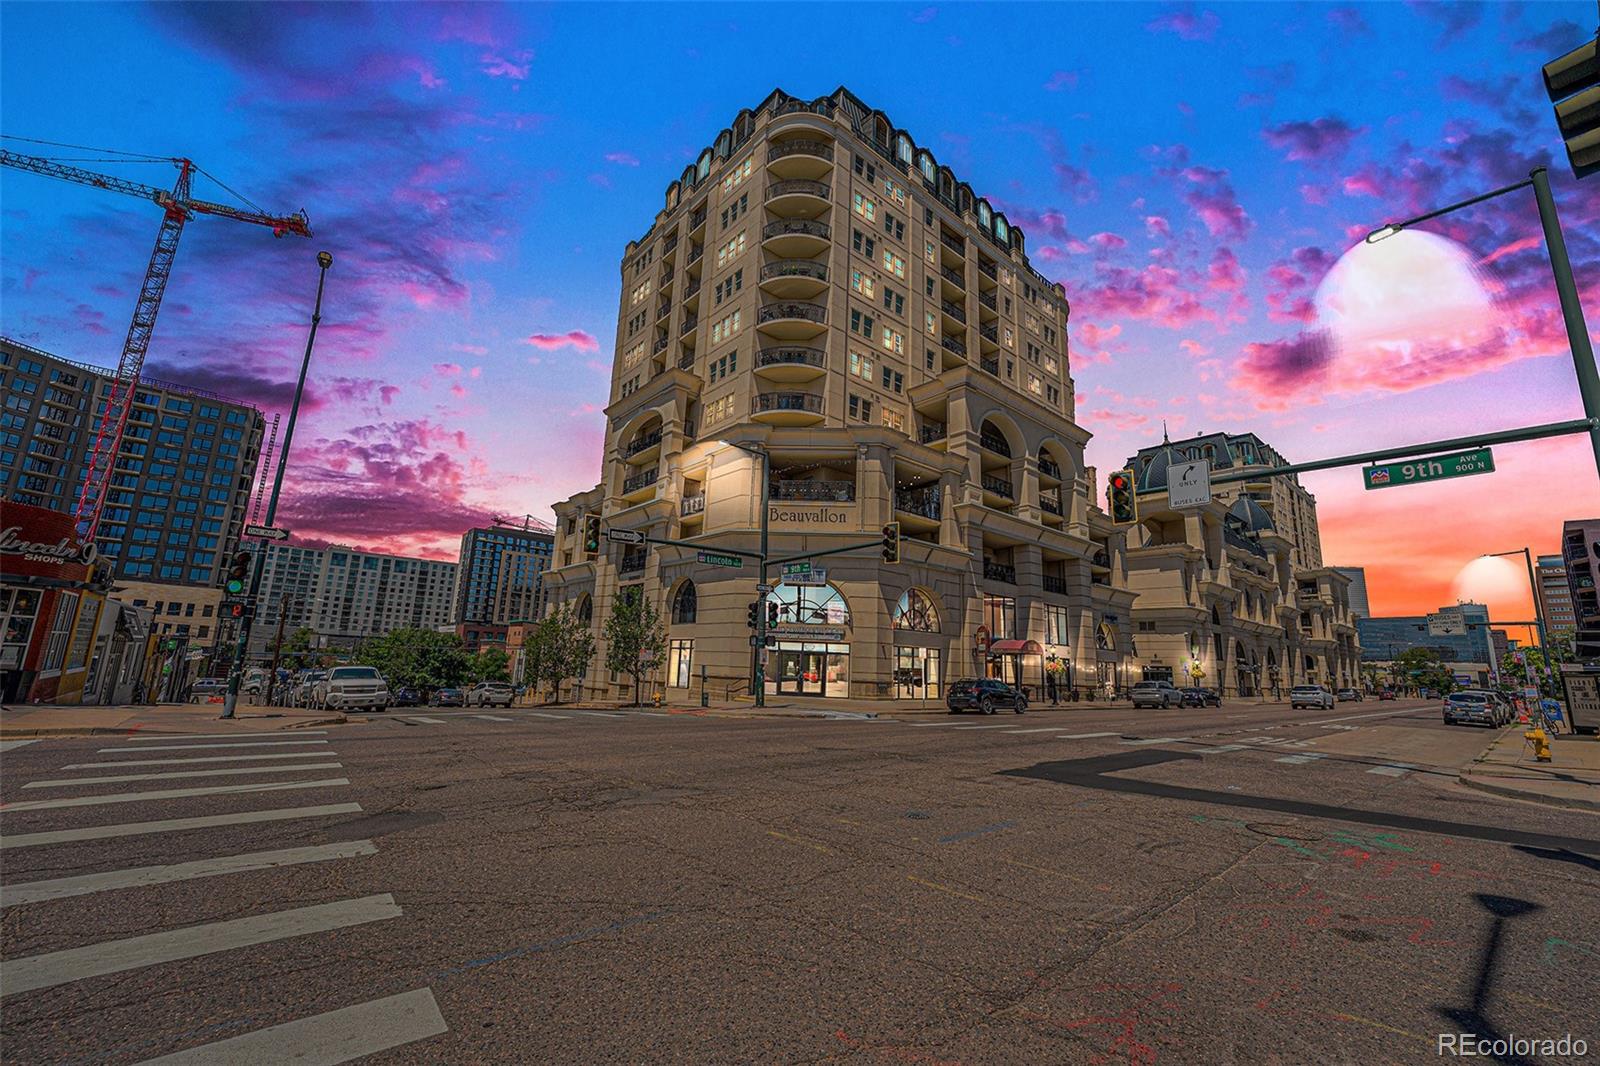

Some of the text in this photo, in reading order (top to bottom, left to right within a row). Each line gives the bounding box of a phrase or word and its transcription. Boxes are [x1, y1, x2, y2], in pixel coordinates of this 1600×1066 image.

[1402, 454, 1477, 480] 9th Ave
[1455, 461, 1485, 473] 900 N
[1178, 479, 1198, 488] ONLY
[769, 507, 847, 523] Beauvallon
[24, 552, 65, 566] SHOPS
[706, 555, 732, 566] Lincoln
